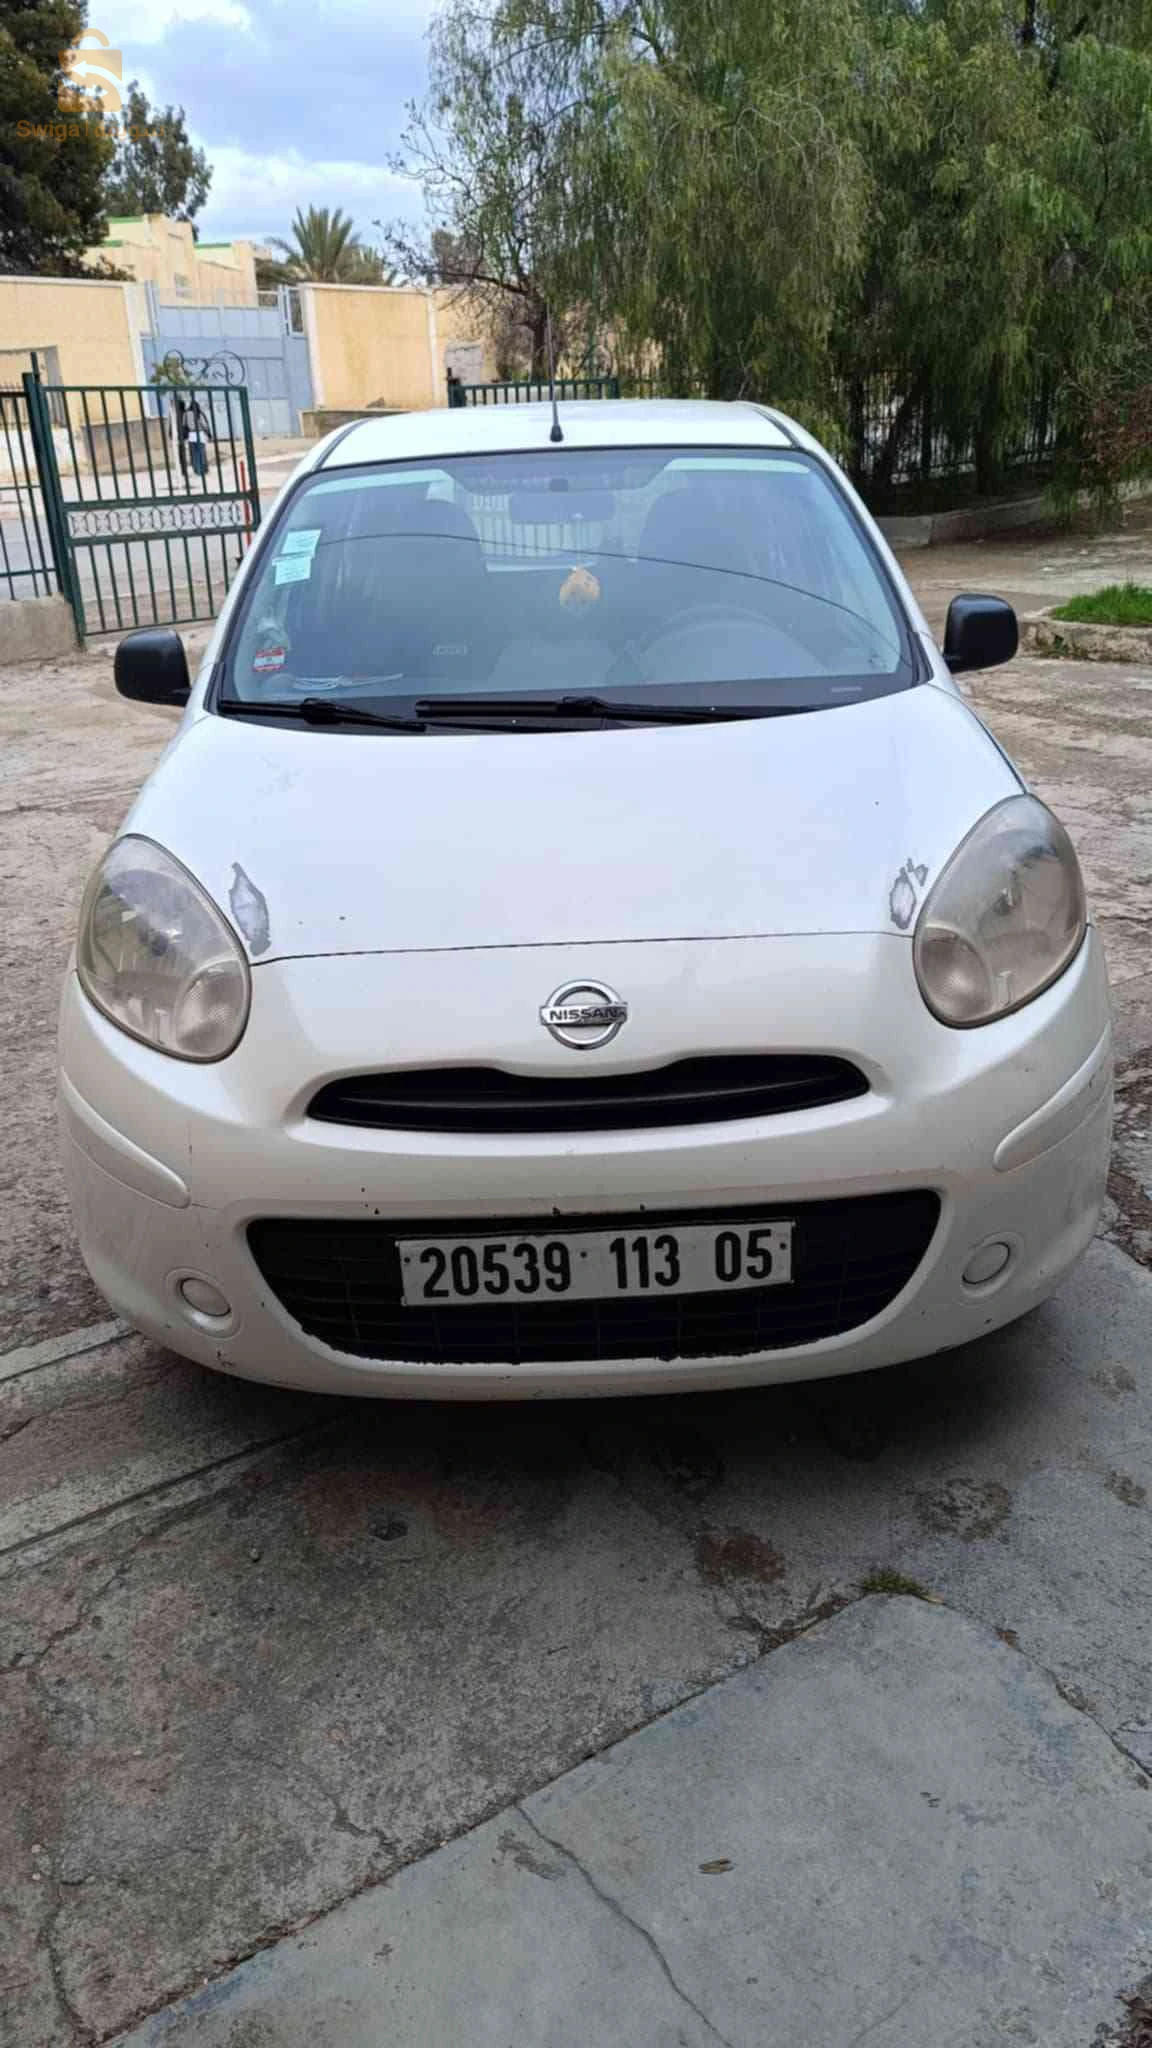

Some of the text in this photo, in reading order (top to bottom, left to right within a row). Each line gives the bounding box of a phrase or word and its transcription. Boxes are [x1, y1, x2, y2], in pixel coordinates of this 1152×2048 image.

[549, 1007, 619, 1021] NISSAN
[419, 1228, 773, 1299] 20539 113 05
